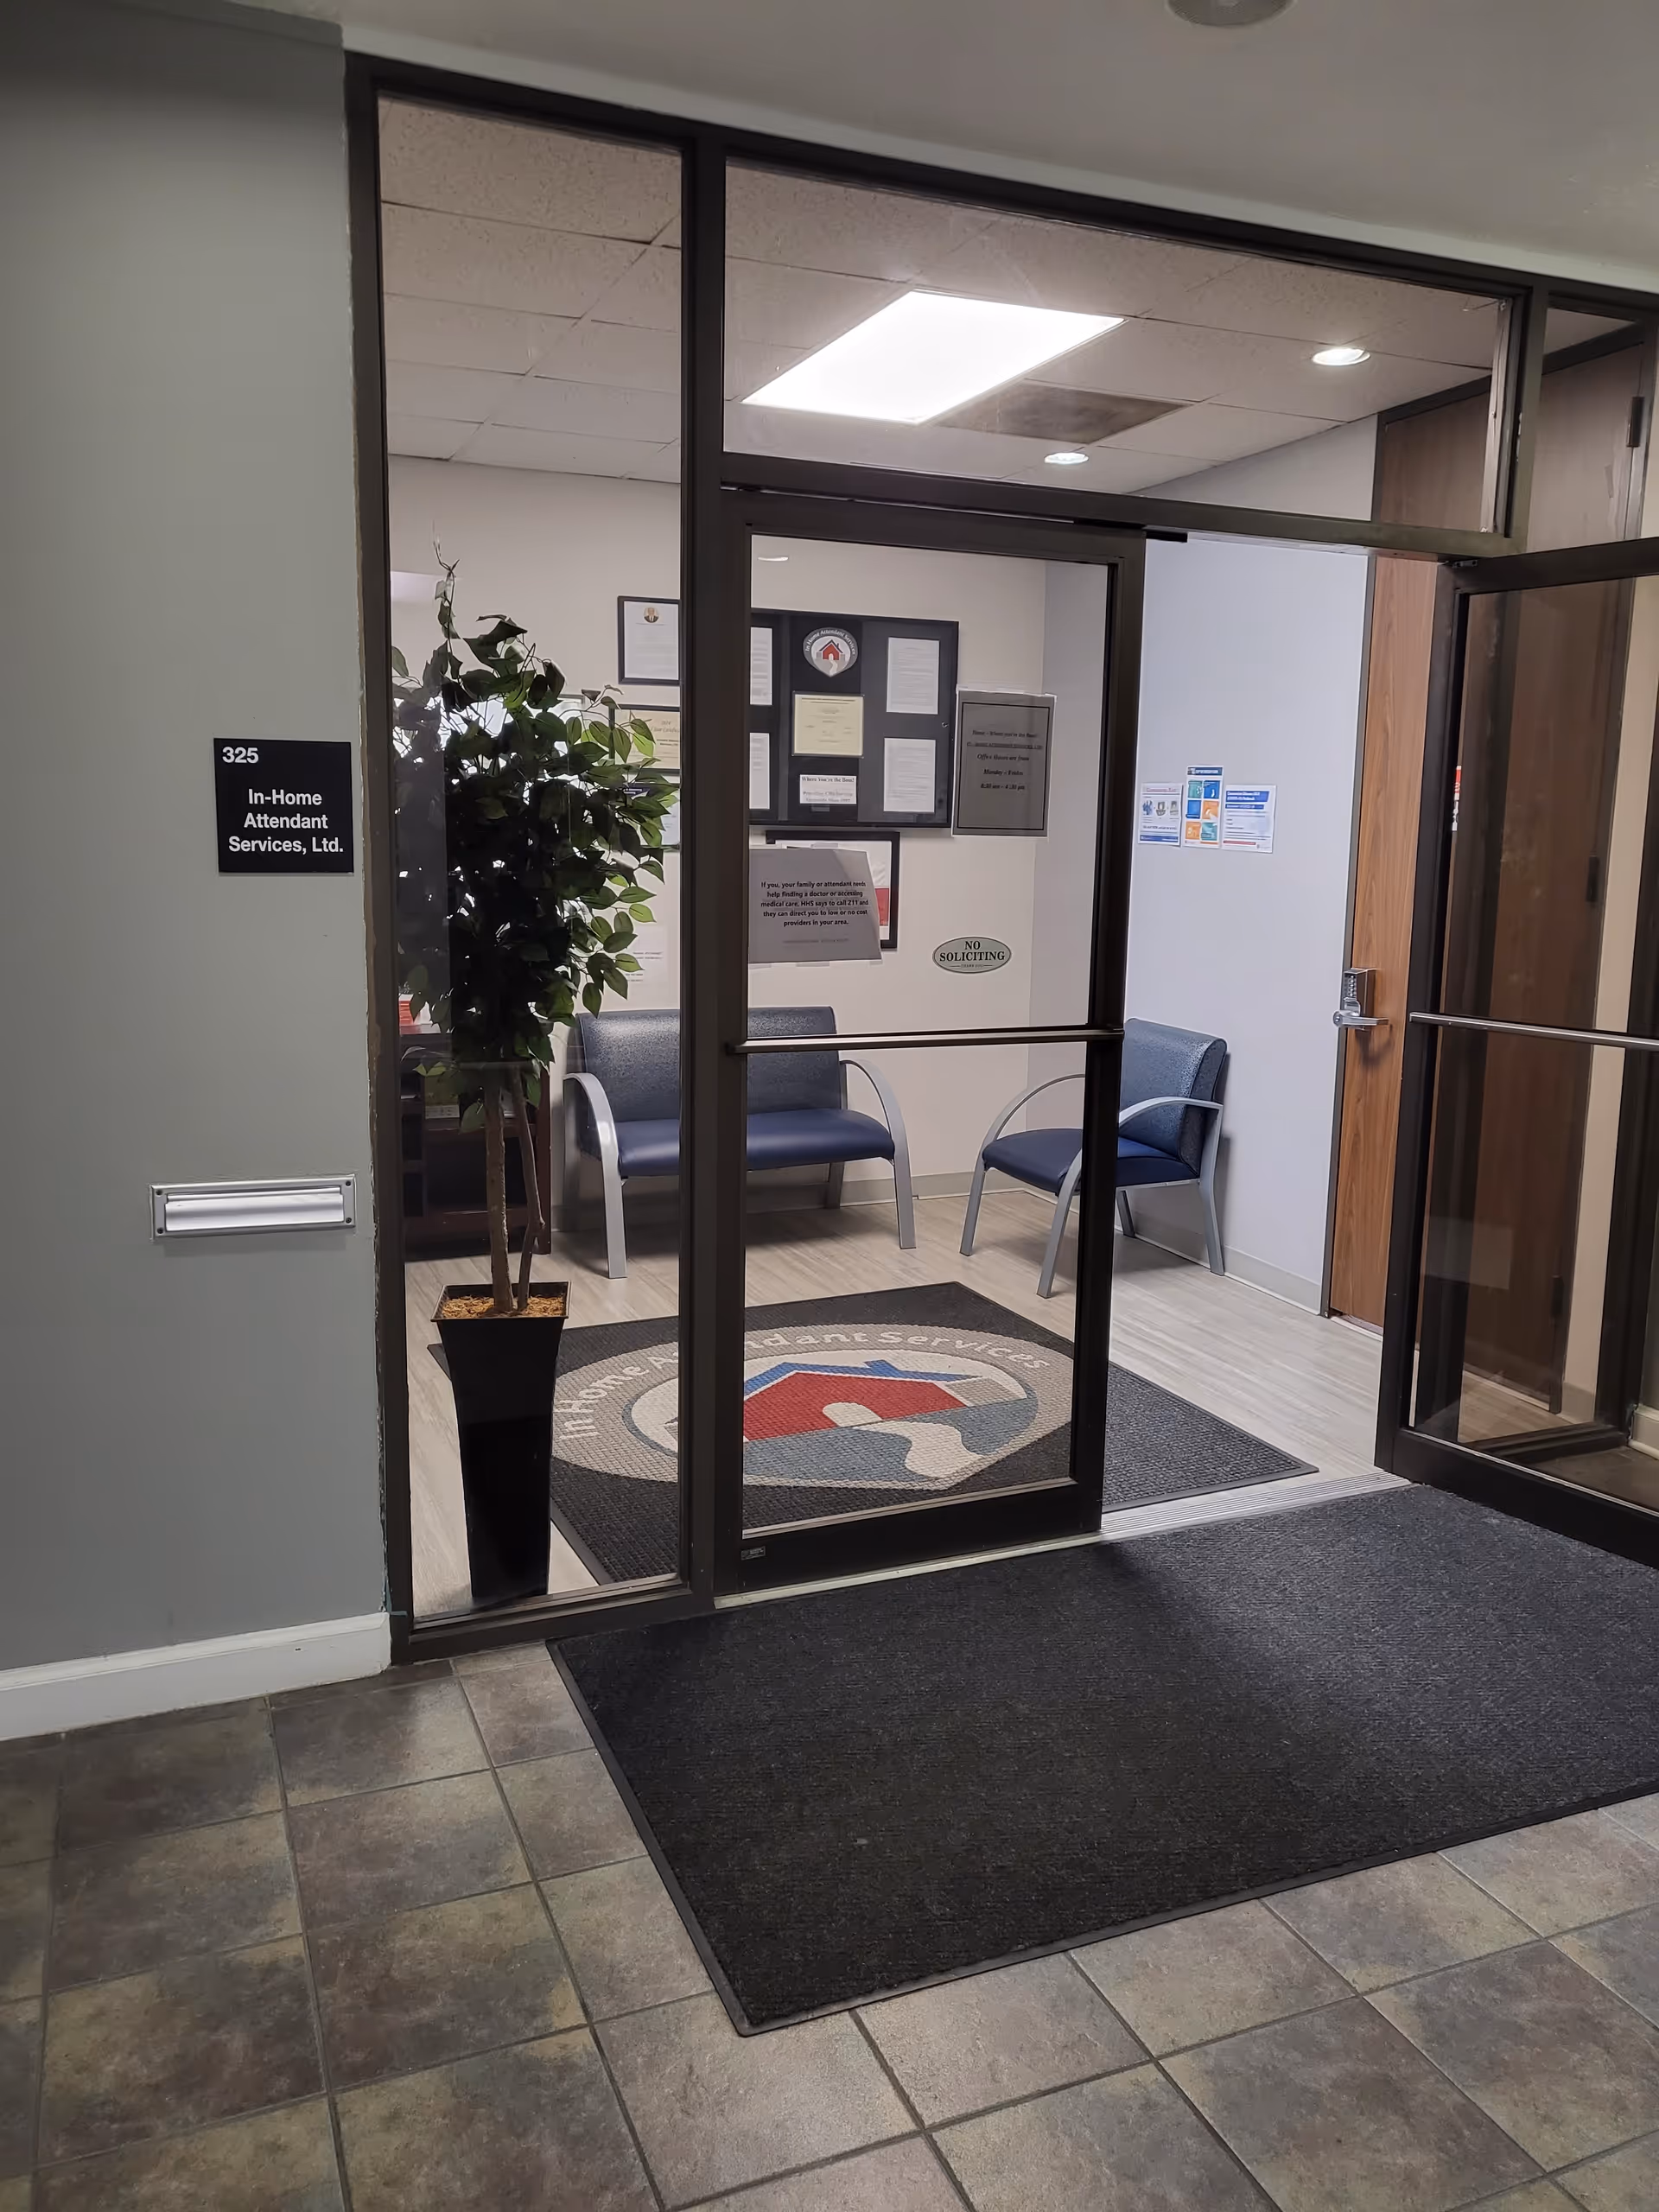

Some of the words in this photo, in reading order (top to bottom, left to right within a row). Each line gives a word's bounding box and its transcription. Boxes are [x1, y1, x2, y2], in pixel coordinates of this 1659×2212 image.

[222, 747, 259, 764] 325
[248, 788, 322, 805] In-Home
[244, 812, 328, 829] Attendant
[228, 836, 307, 855] Services,
[312, 836, 344, 853] Ltd.
[796, 880, 815, 889] family
[964, 940, 981, 950] NO
[939, 951, 1006, 962] SOLICITING
[878, 1332, 1051, 1370] Services
[552, 1365, 650, 1414] Home
[559, 1418, 601, 1440] In
